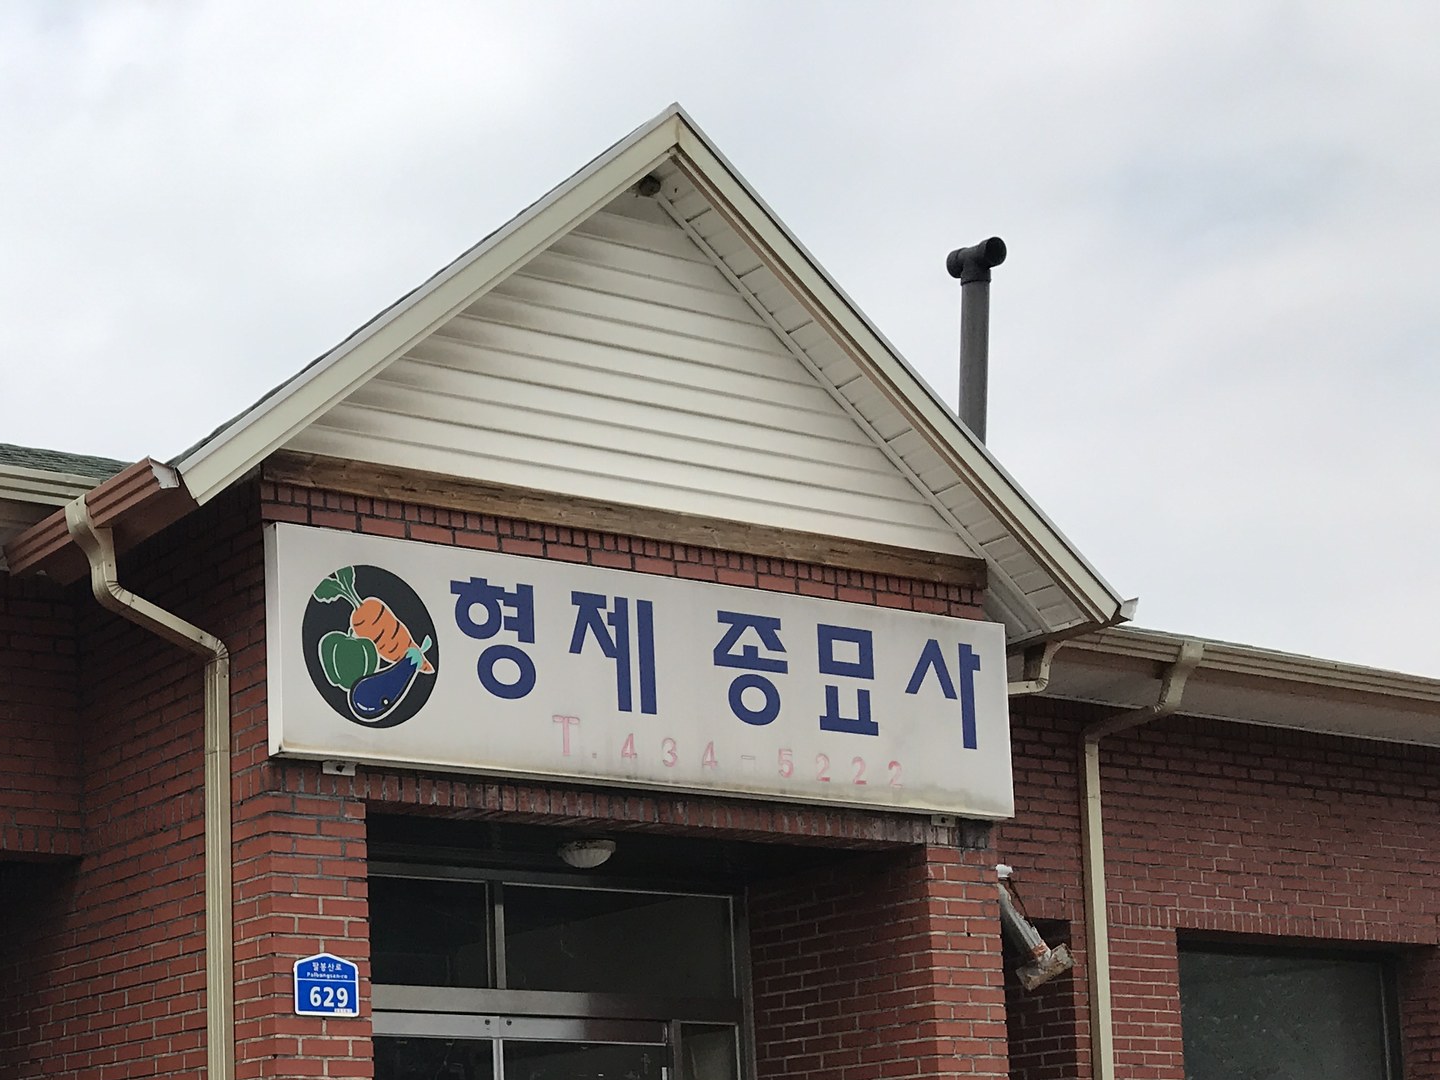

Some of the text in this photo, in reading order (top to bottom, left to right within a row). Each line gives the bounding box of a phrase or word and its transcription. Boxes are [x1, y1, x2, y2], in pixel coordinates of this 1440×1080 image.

[449, 577, 981, 749] 형제 종묘사
[310, 986, 348, 1007] 629
